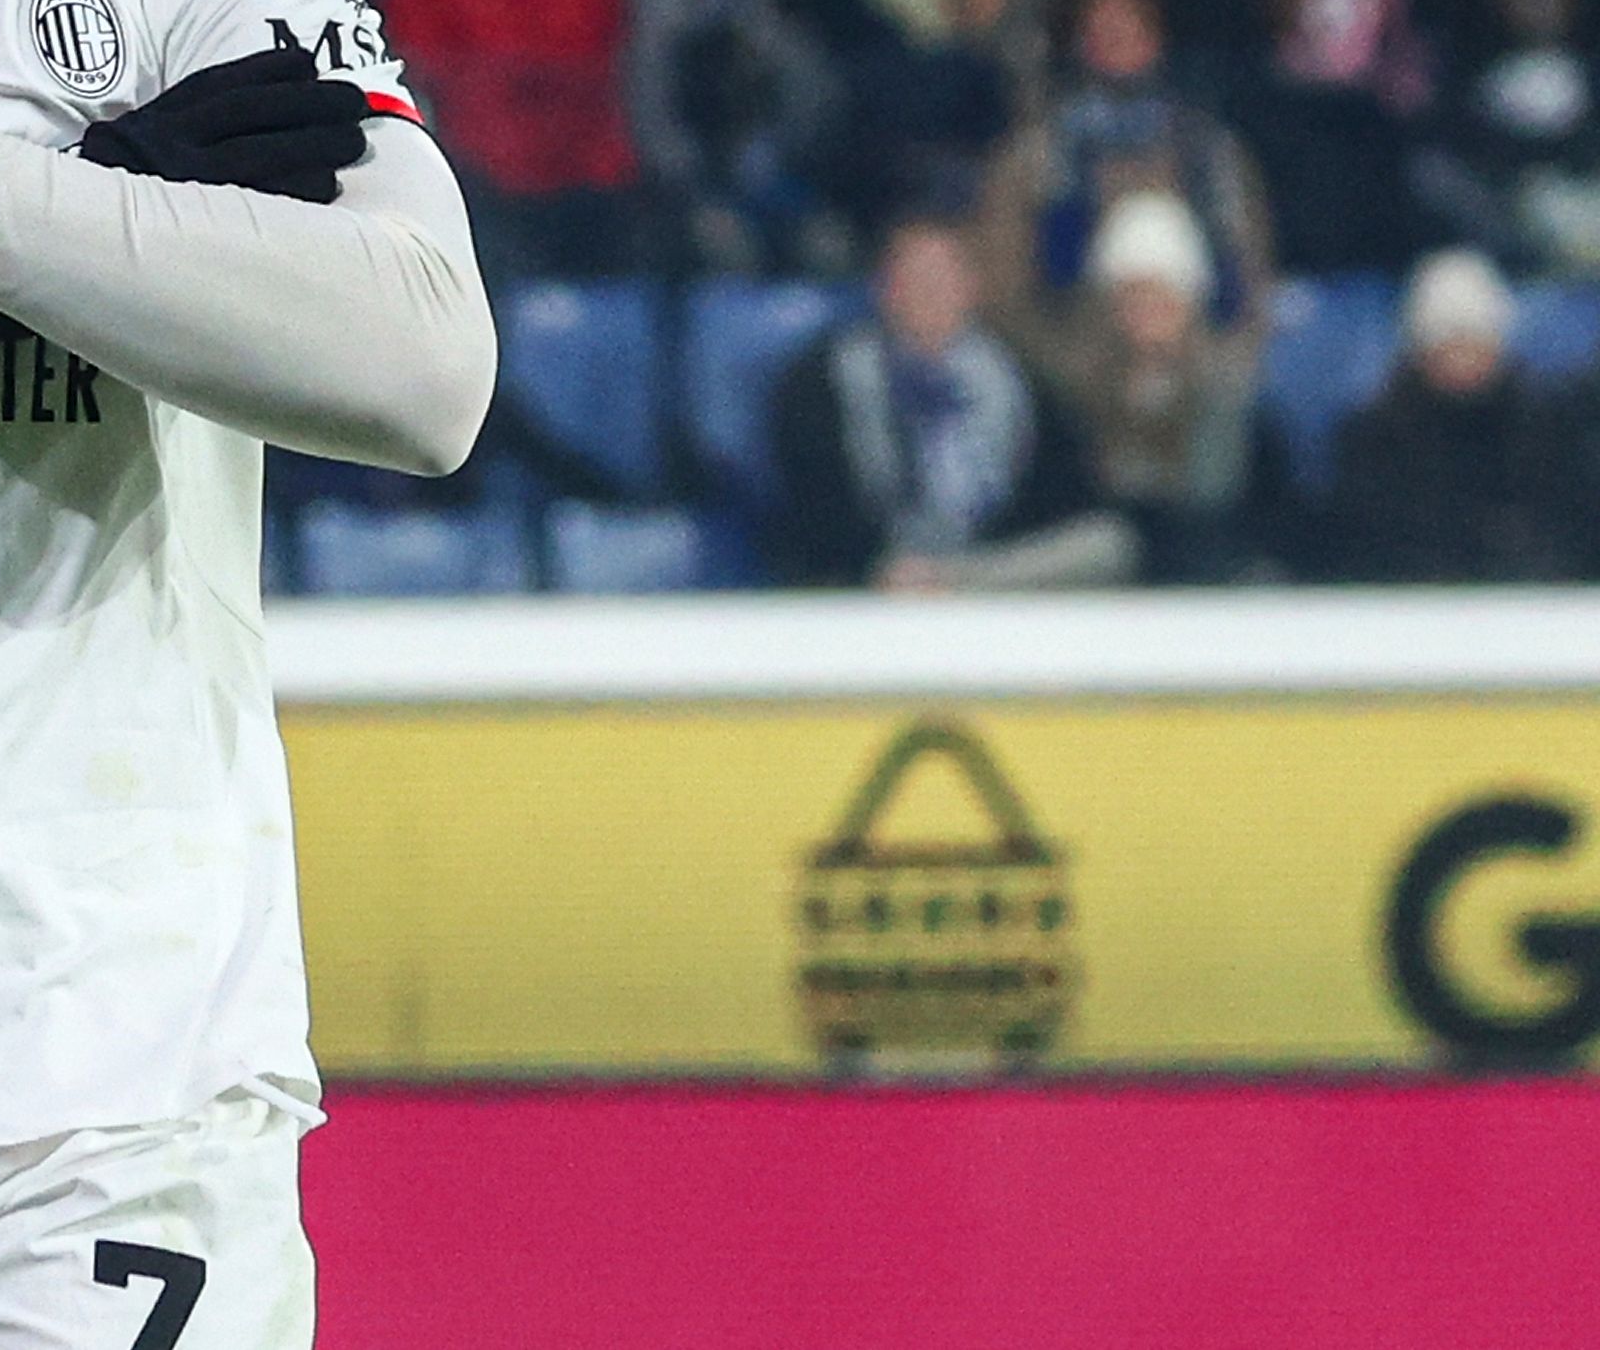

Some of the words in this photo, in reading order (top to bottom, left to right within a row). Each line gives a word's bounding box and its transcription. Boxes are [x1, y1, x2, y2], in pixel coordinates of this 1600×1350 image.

[264, 18, 390, 71] MS
[65, 71, 107, 84] 1899
[93, 1238, 206, 1350] 7
